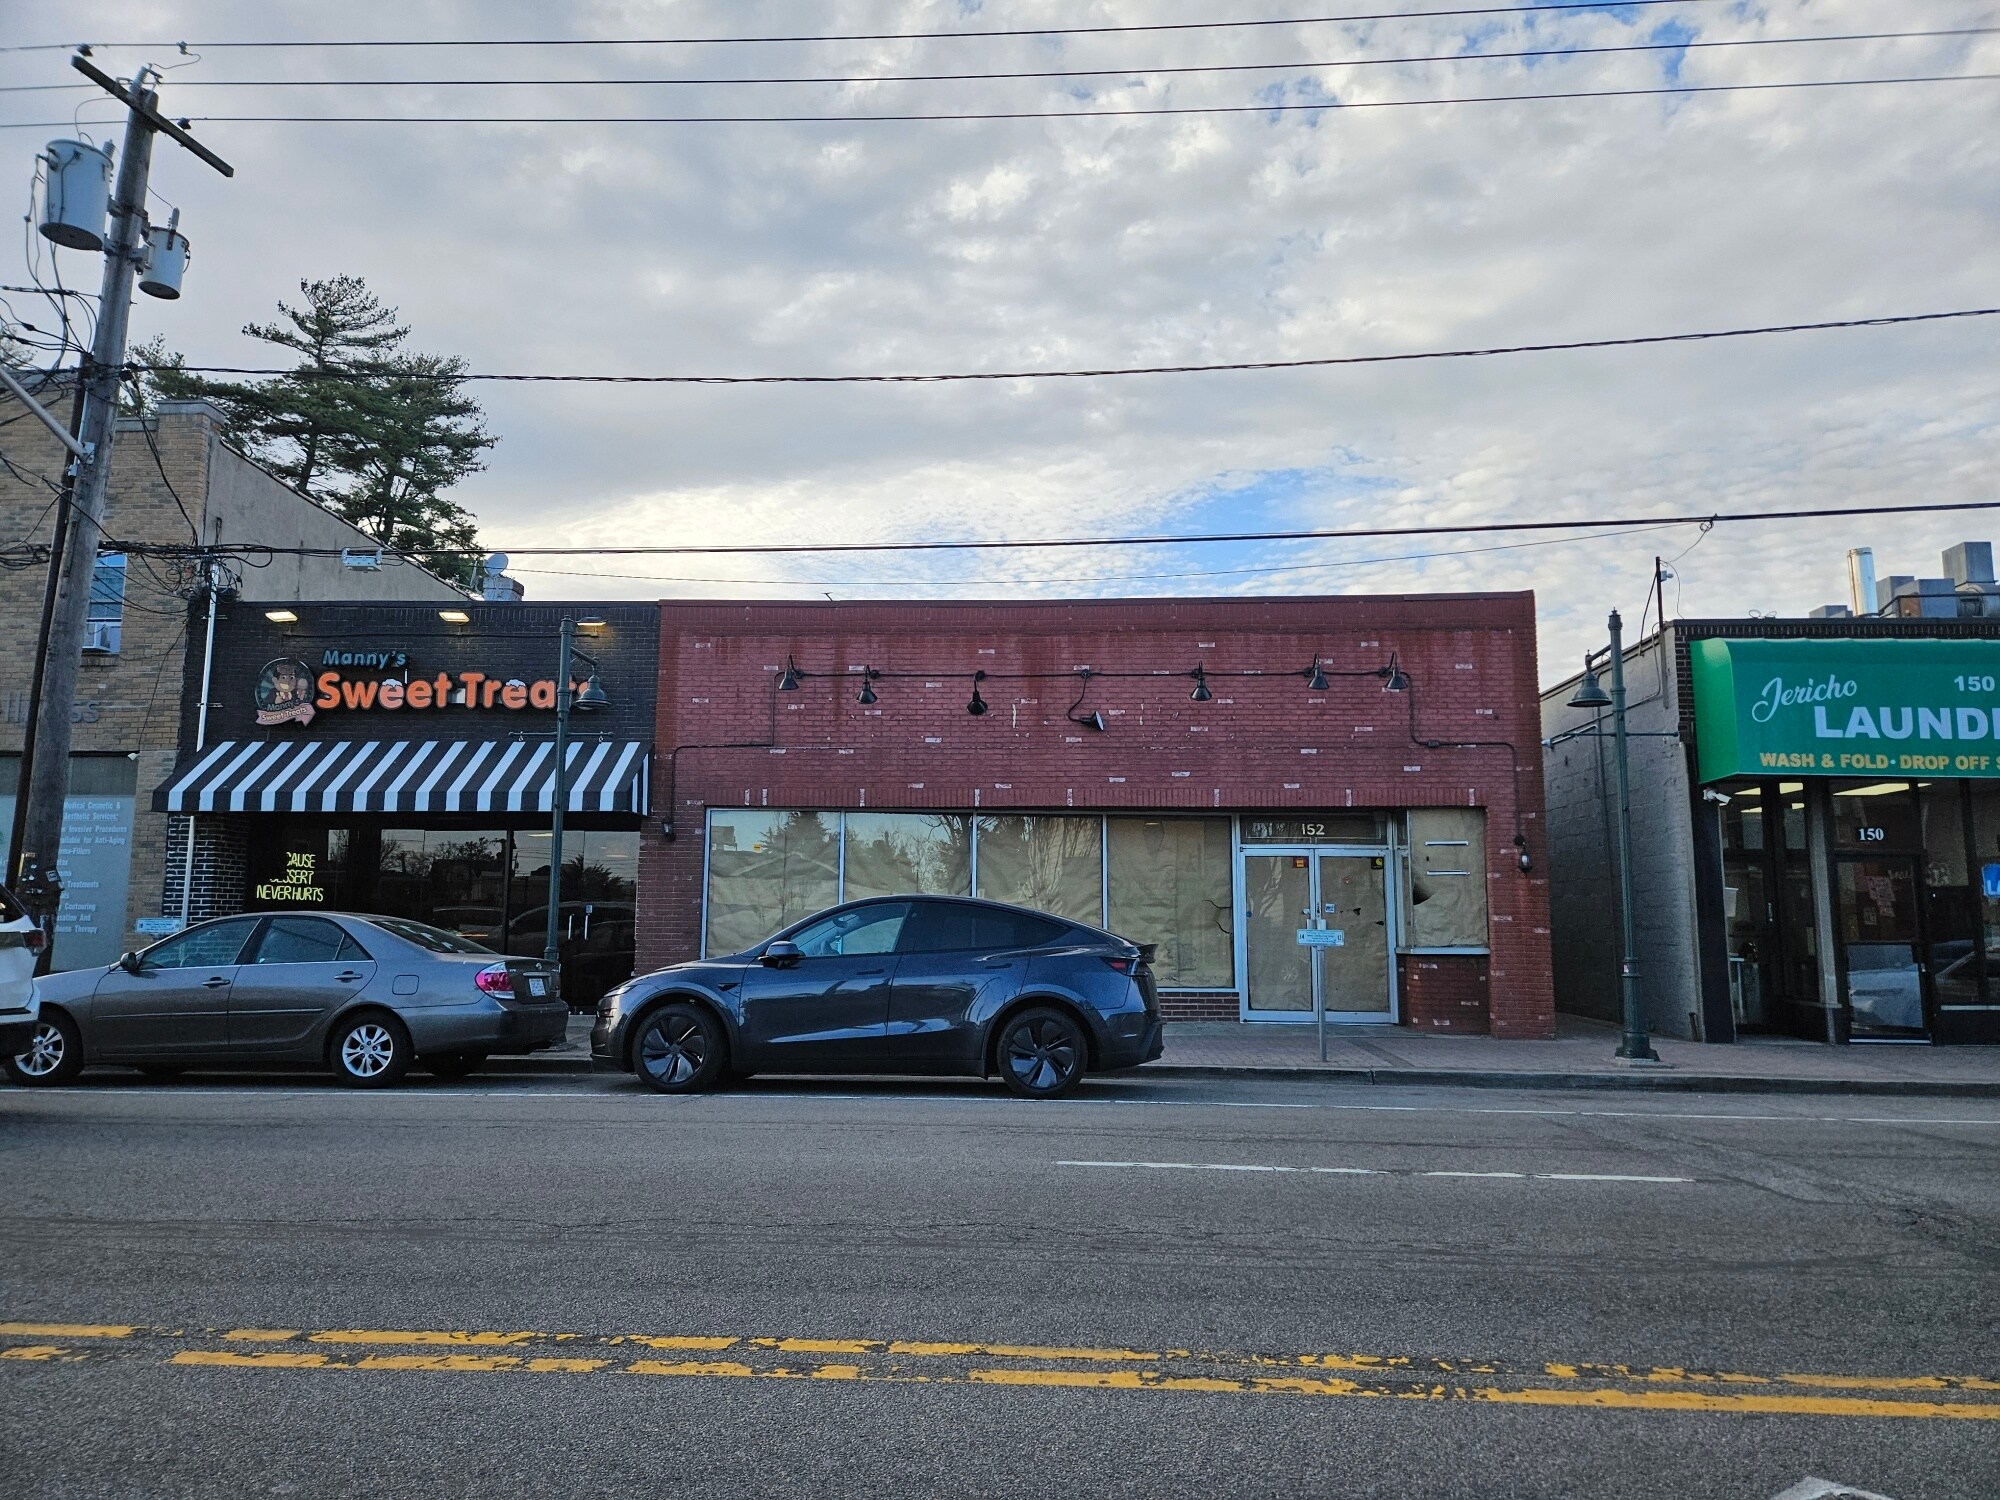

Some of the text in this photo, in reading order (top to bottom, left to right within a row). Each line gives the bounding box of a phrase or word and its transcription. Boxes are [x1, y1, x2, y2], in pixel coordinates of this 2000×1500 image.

[322, 650, 407, 669] Manny's
[316, 671, 590, 710] Sweet Trea
[1954, 675, 1996, 692] 150
[1752, 674, 1858, 723] Jericho
[262, 706, 307, 721] Sweet Treats
[1814, 706, 2000, 740] LAUND
[1759, 752, 1815, 768] WASH
[1821, 753, 1835, 769] &
[1840, 754, 1889, 769] FOLD
[1900, 754, 1950, 770] DROP
[1955, 755, 1990, 771] OFF
[88, 801, 113, 810] Cosmetic
[95, 825, 128, 833] Procedures
[1301, 823, 1325, 836] 152
[1858, 827, 1884, 841] 150
[83, 836, 92, 844] for
[94, 836, 126, 846] Anti-Aging
[67, 880, 100, 888] Treatments
[256, 884, 324, 902] NEVER HURTS
[65, 902, 96, 912] Contouring
[79, 913, 91, 922] And
[75, 924, 97, 934] Therapy
